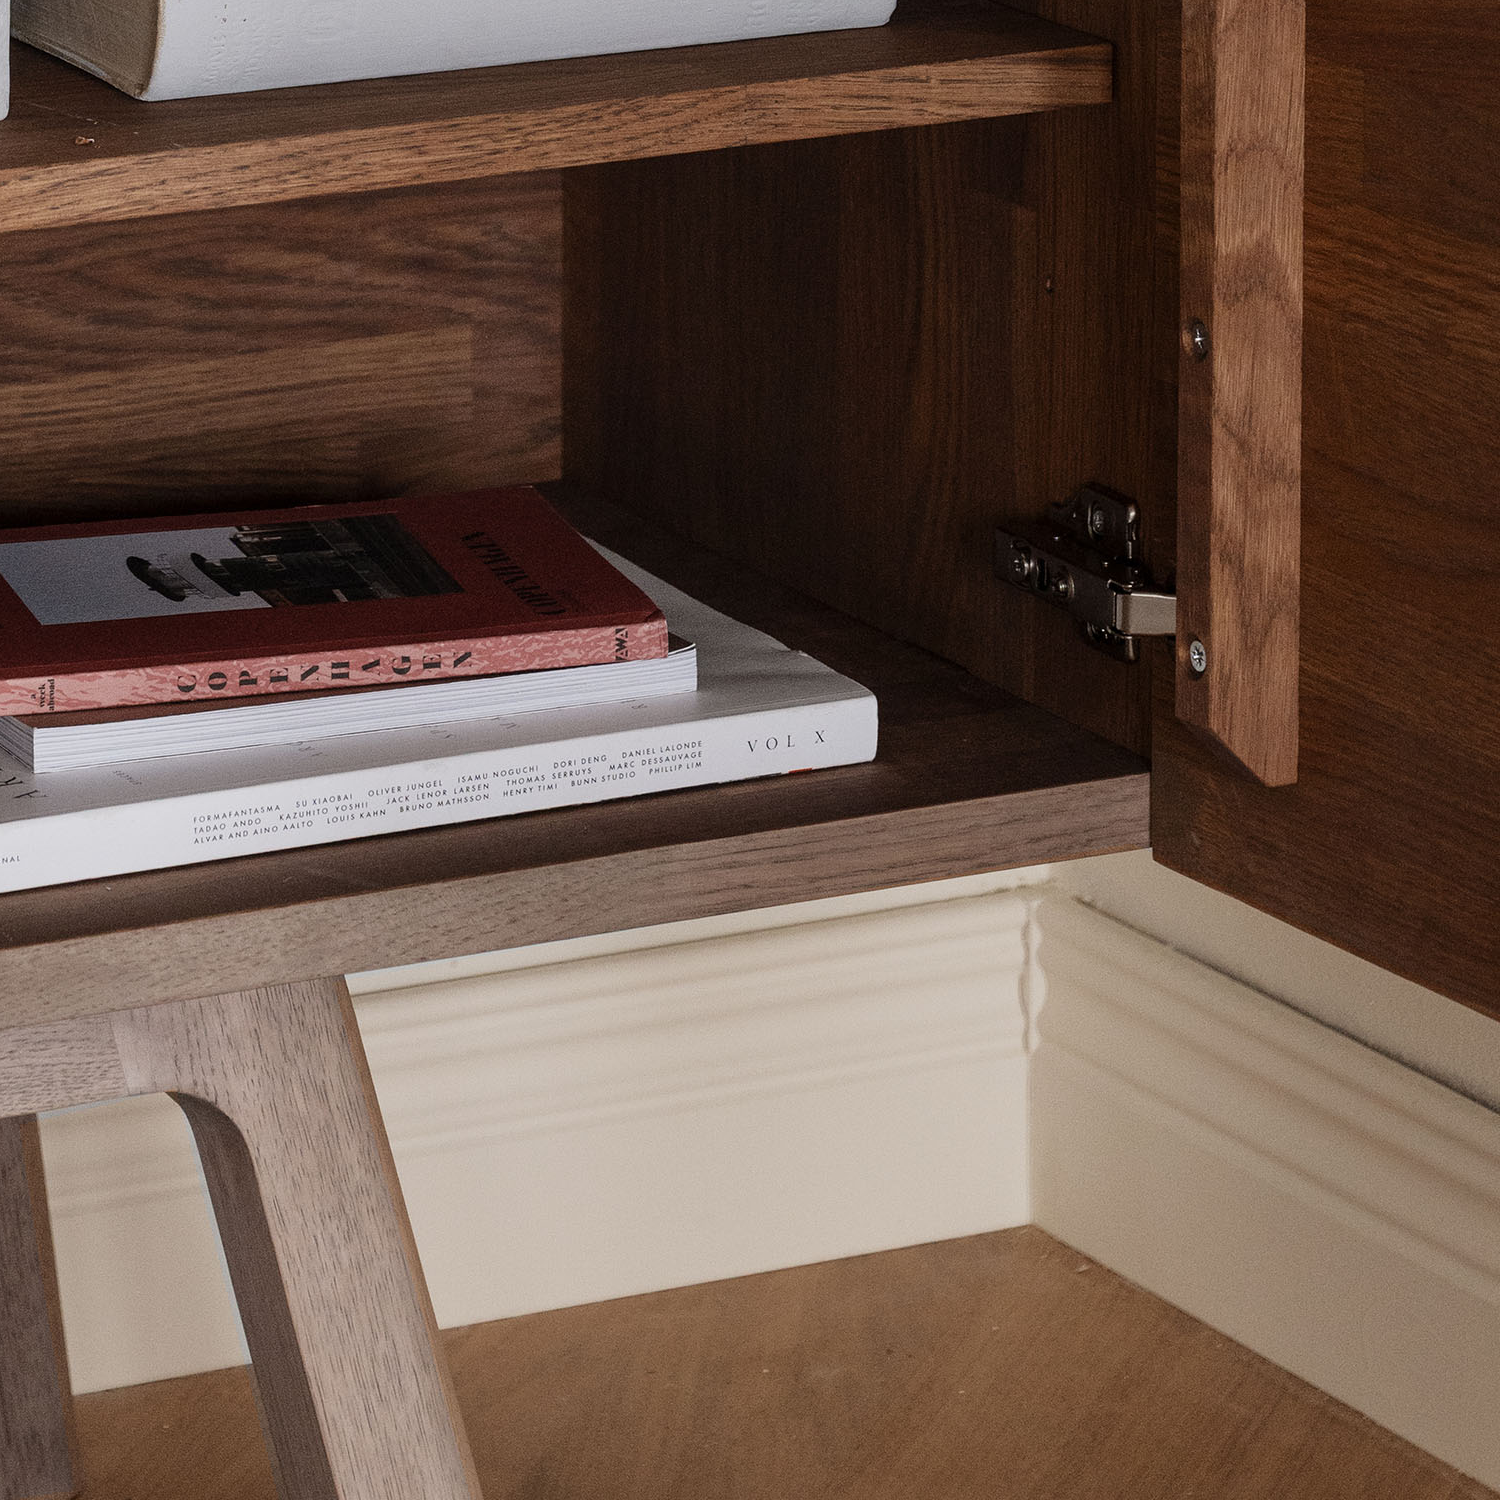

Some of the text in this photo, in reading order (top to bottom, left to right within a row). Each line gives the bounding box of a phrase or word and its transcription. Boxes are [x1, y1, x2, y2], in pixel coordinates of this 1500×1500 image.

[176, 651, 473, 693] COPENHAGEN
[38, 683, 46, 708] week
[47, 678, 55, 711] abroad
[747, 729, 826, 752] VOL X
[193, 740, 702, 823] FORMAFANTASMA SU XIAOBAI OLIVER JUNGEL ISAMU NOGUCHI DORI DENG DANIEL LALONDE
[194, 751, 702, 834] TADAO ANDO KAZUHITO YOSHII JACK LENOR LARSEN THOMAS SERRUYS MARC DESSAUVAGE
[194, 761, 702, 845] ALVAR AND AINO AALTO LOUIS KAHN BRUNO MATHSSON HENRY TIMI BUNN STUDIO PHILLIP LIM
